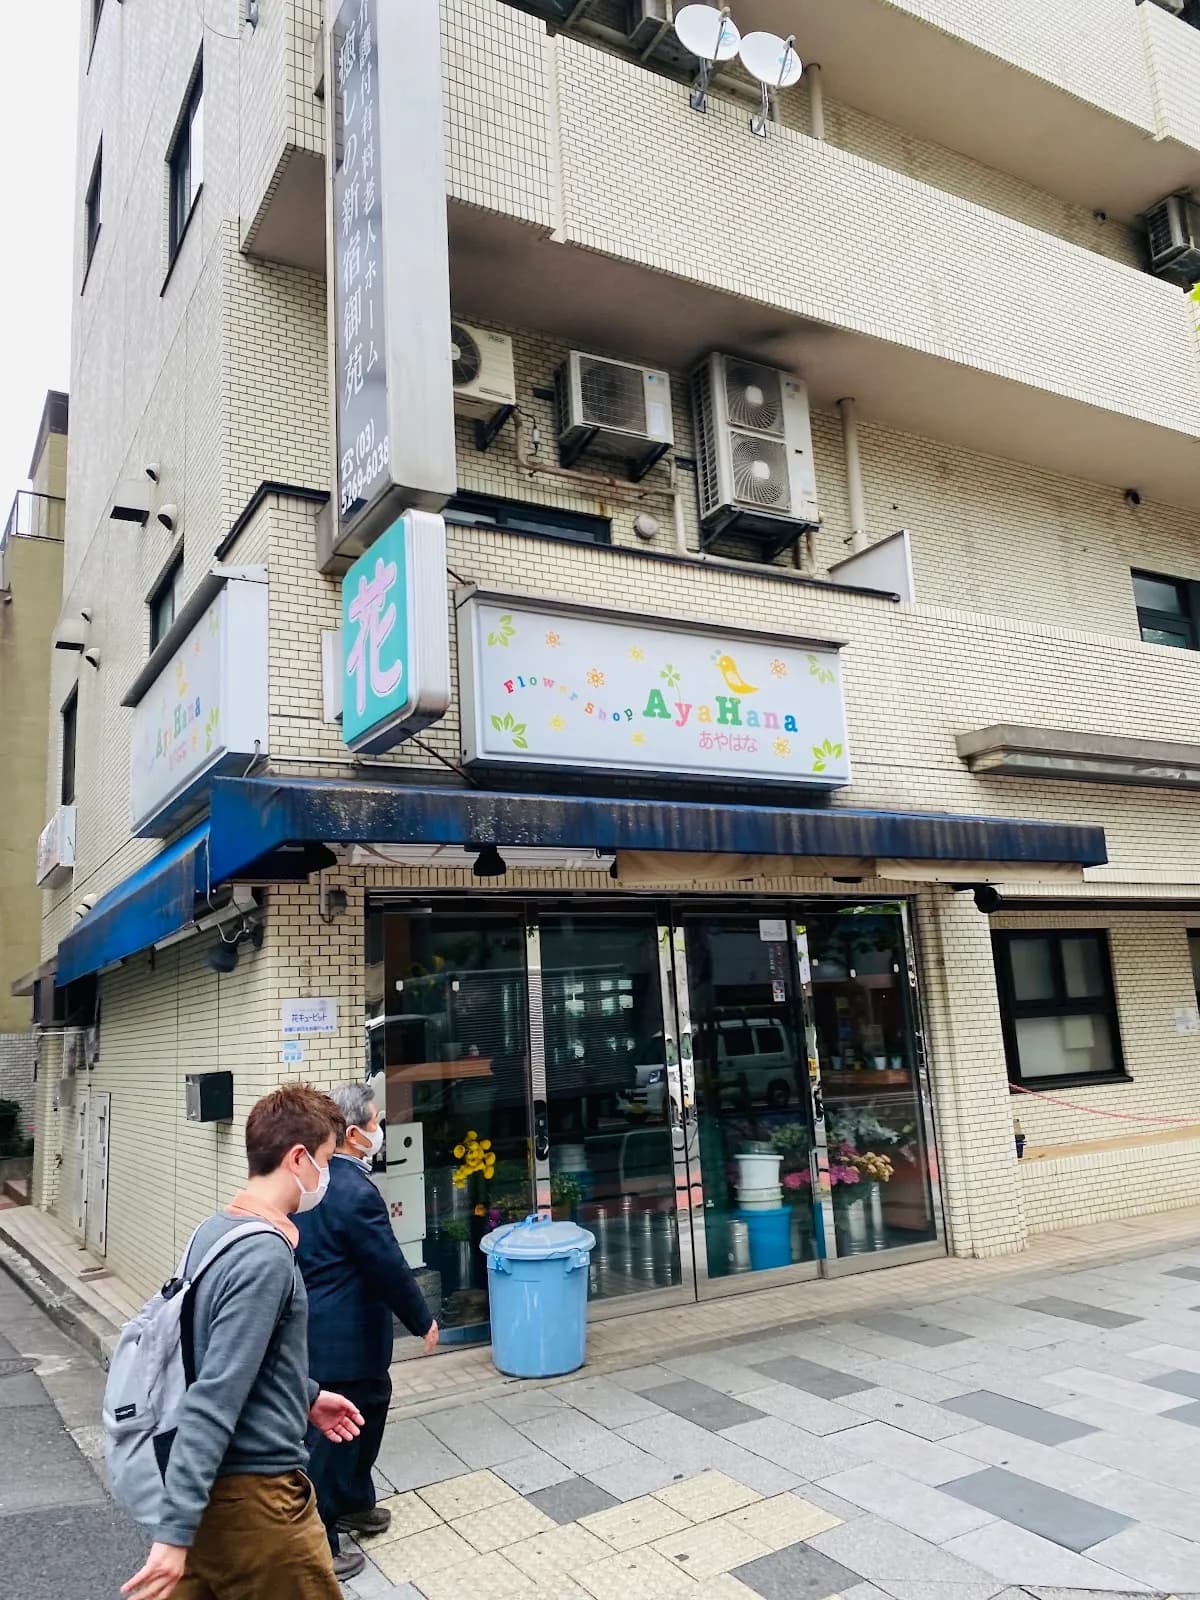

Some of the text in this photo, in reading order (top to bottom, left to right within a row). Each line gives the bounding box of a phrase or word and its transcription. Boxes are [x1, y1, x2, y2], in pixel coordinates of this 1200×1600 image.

[355, 418, 375, 466] (03)
[341, 435, 389, 516] 5269-6038
[346, 557, 403, 717] 花
[642, 688, 799, 733] AyaHana
[698, 730, 759, 753] あやはな
